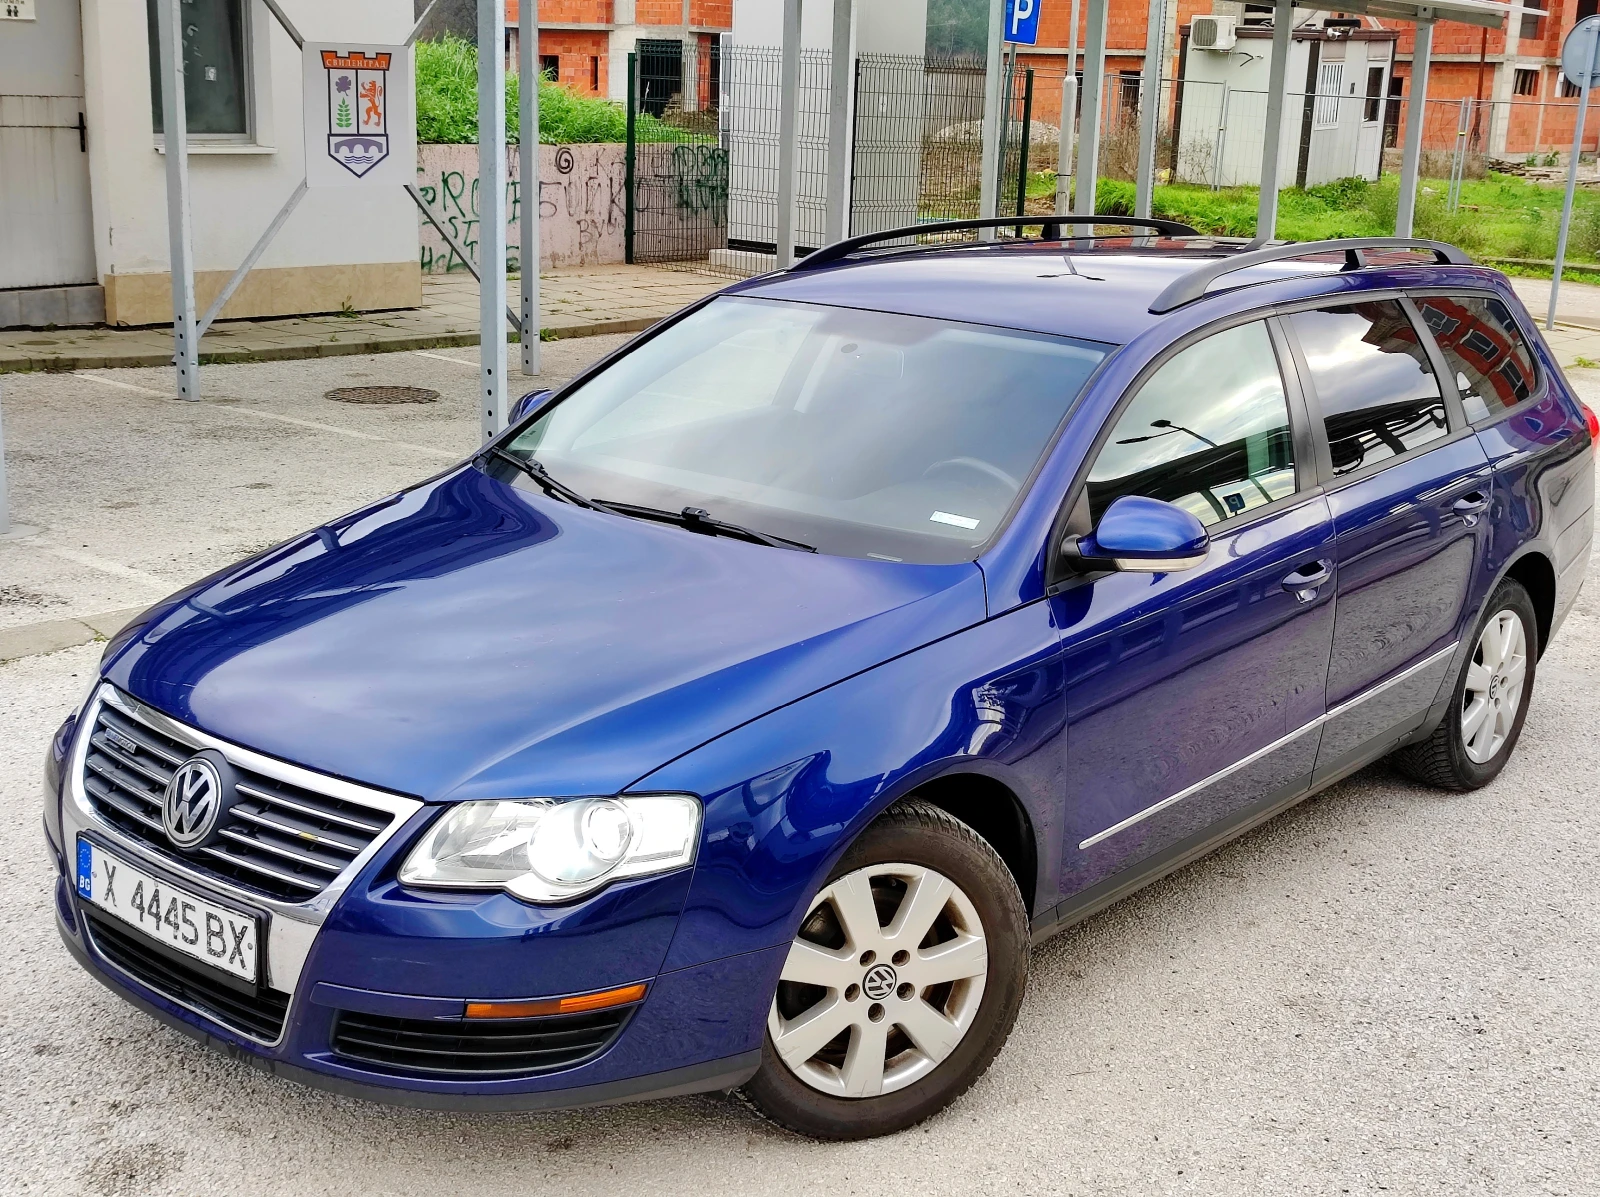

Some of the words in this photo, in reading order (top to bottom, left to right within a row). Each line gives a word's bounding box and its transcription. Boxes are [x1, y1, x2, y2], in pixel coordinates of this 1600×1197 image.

[1012, 0, 1034, 35] P
[326, 58, 387, 69] СВИЛЕНГРАД
[79, 874, 91, 891] BG
[103, 859, 118, 908] X
[131, 879, 199, 946] 4445
[205, 911, 249, 971] BX
